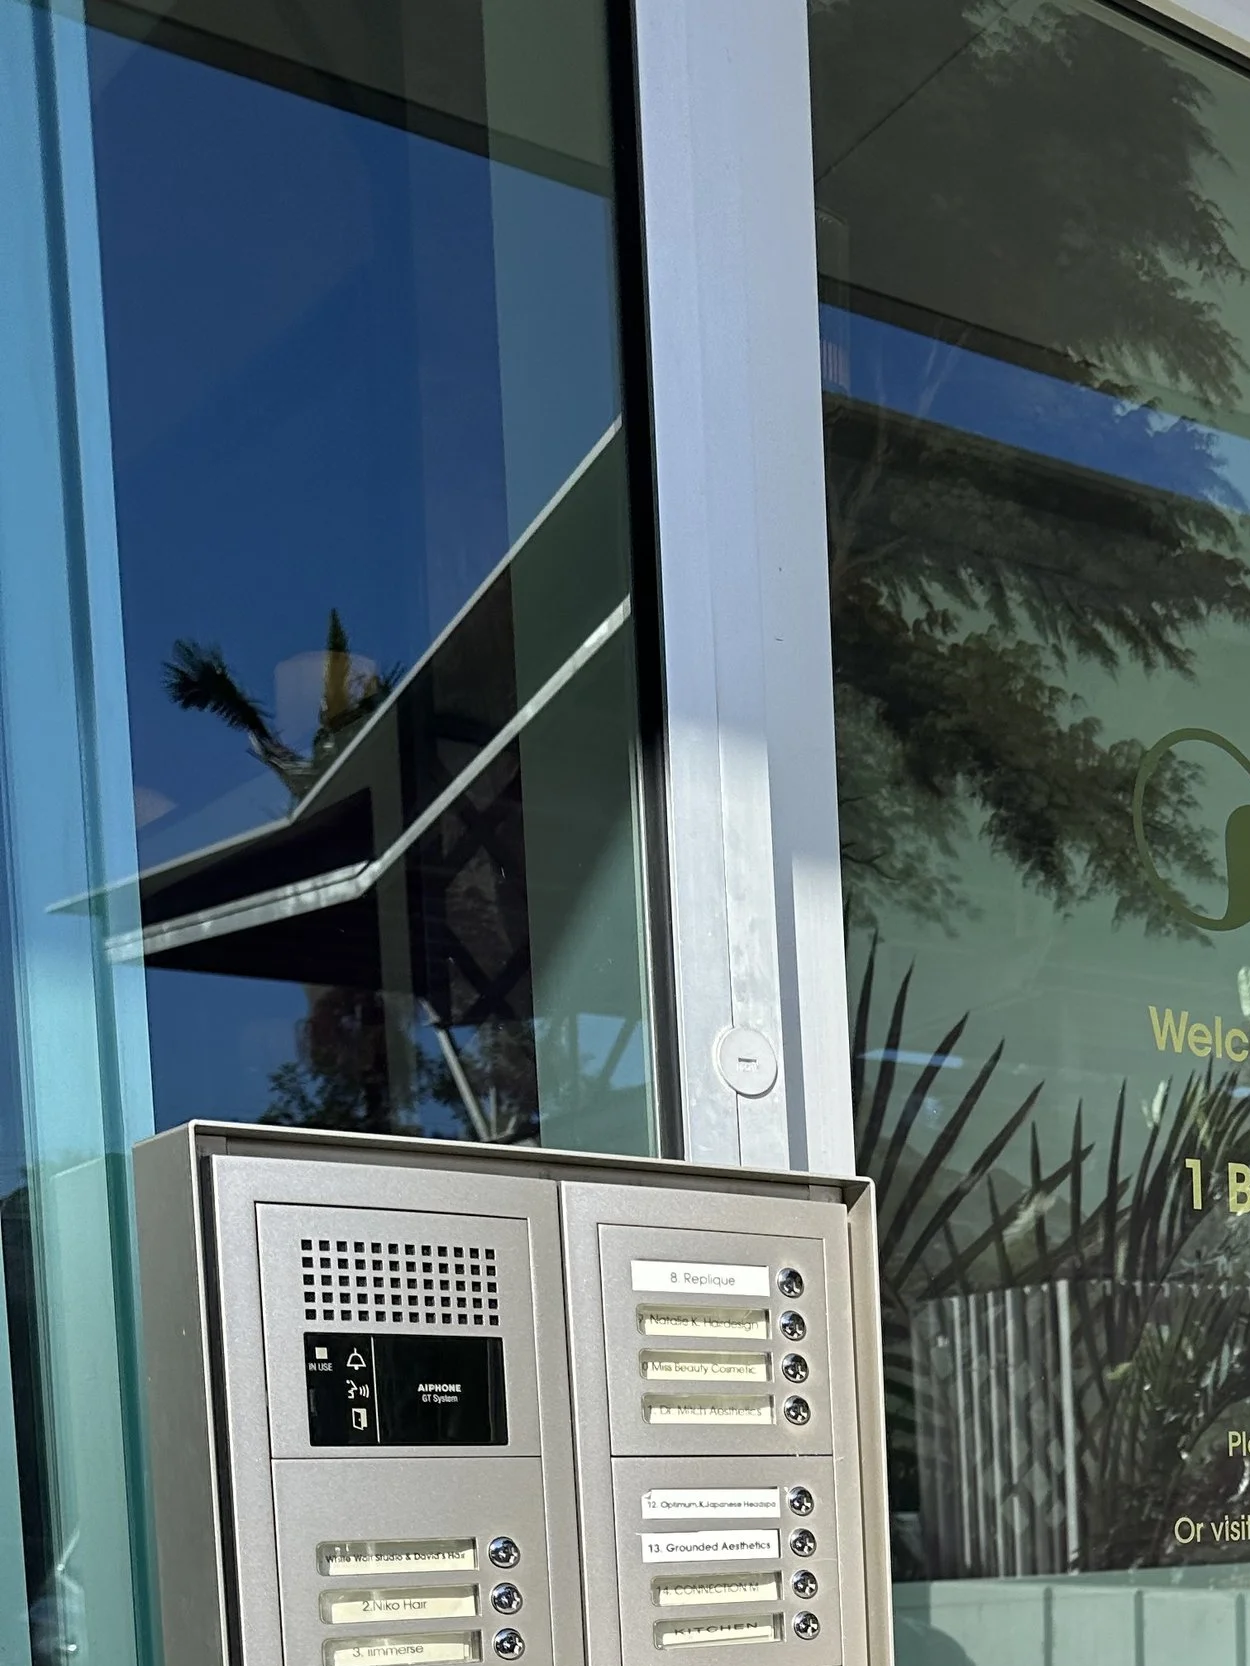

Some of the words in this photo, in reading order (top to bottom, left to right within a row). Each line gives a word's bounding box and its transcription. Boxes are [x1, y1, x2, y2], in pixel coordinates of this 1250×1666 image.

[1184, 1158, 1203, 1211] 1
[684, 1273, 736, 1287] Replique
[308, 1362, 317, 1372] IN
[317, 1362, 333, 1372] USE
[675, 1363, 708, 1375] Beauty
[417, 1383, 462, 1393] AIPHONE
[421, 1394, 432, 1403] GT
[432, 1394, 459, 1404] System
[1174, 1516, 1204, 1545] Or
[665, 1542, 719, 1553] Grounded
[721, 1541, 771, 1551] Aesthetics
[405, 1552, 412, 1561] &
[403, 1599, 427, 1611] Hair
[674, 1622, 758, 1635] KITCHEN
[352, 1646, 364, 1658] 3.
